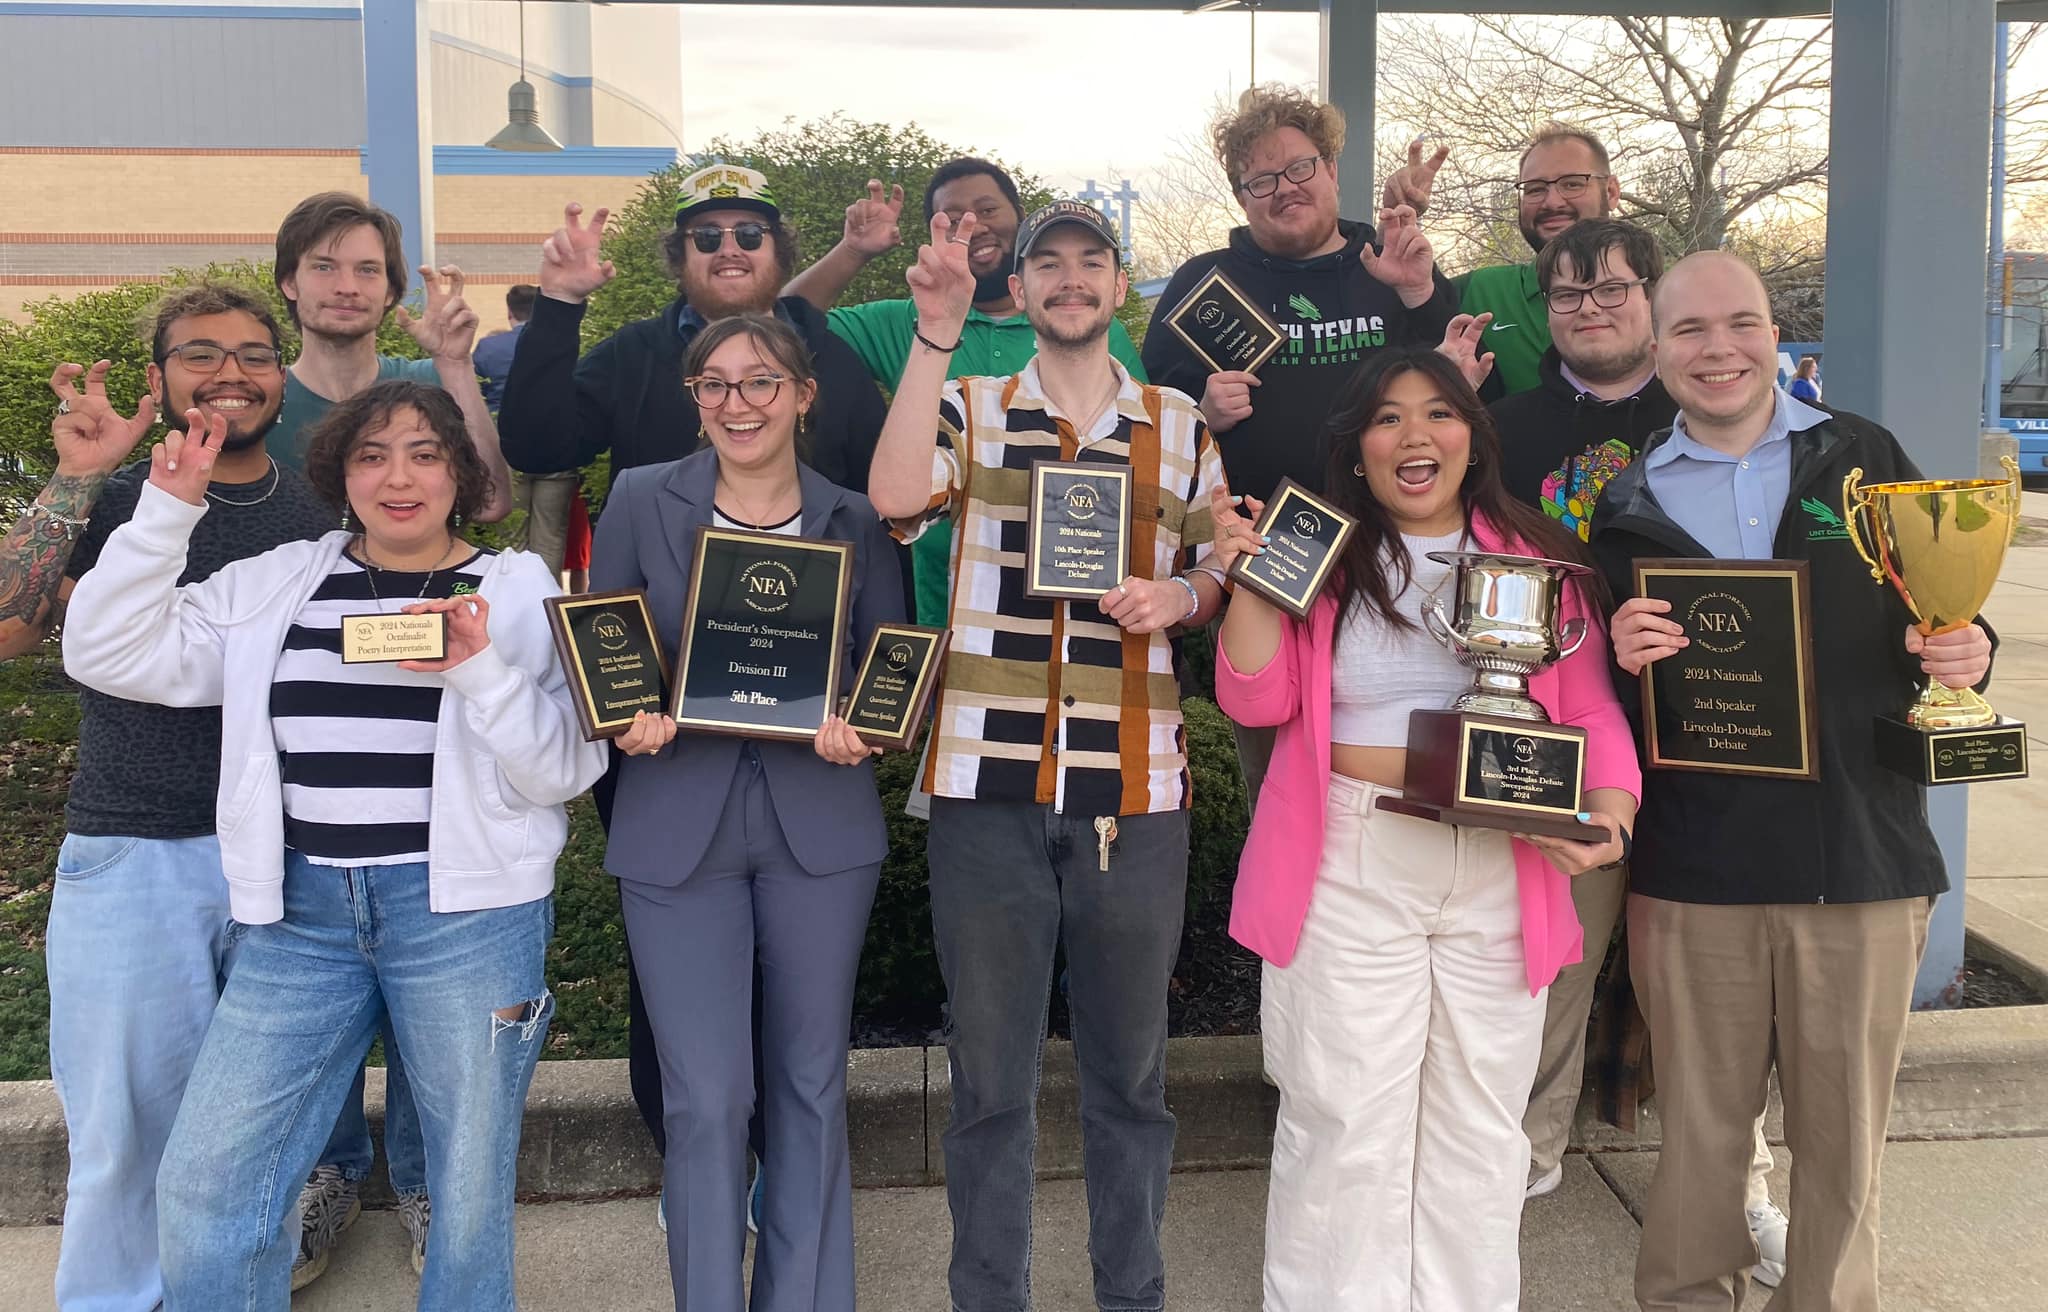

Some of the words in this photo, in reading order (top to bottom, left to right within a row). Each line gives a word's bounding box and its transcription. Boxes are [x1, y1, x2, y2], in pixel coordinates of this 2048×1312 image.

[696, 170, 722, 192] PUPPY
[726, 171, 752, 189] BOWL
[1030, 206, 1056, 231] SAN
[1059, 202, 1103, 226] DIEGO
[1201, 307, 1220, 323] NFA
[1311, 316, 1385, 354] TEXAS
[1070, 495, 1094, 508] NFA
[1296, 516, 1315, 534] NFA
[1075, 528, 1103, 538] Nationals
[1083, 548, 1105, 556] Speaker
[740, 560, 772, 582] NATIONAL
[1055, 560, 1104, 571] Lincoln-Douglas
[1068, 570, 1090, 579] Debate
[749, 576, 787, 596] NFA
[1688, 592, 1718, 620] NATIONAL
[1720, 593, 1752, 622] FORENSIC
[380, 622, 397, 630] 2024
[400, 620, 432, 629] Nationals
[1698, 613, 1742, 632] NFA
[386, 633, 426, 641] Octafinalist
[598, 625, 624, 638] NFA
[707, 620, 758, 633] President's
[761, 625, 818, 640] Sweepstakes
[358, 646, 380, 655] Poetry
[384, 644, 431, 654] Interpretation
[750, 638, 773, 648] 2024
[1696, 639, 1746, 653] ASSOCIATION
[890, 652, 907, 663] NFA
[728, 662, 770, 676] Division
[773, 666, 787, 677] III
[1684, 668, 1710, 681] 2024
[1713, 669, 1763, 683] Nationals
[730, 691, 747, 703] 5th
[751, 692, 778, 706] Place
[1694, 698, 1713, 710] 2nd
[1716, 698, 1756, 713] Speaker
[1683, 721, 1772, 737] Lincoln-Douglas
[1517, 744, 1532, 755] NFA
[1709, 738, 1748, 750] Debate
[1507, 765, 1519, 773] 3rd
[1521, 766, 1539, 775] Place
[1481, 770, 1538, 783] Lincoln-Douglas
[1539, 778, 1564, 786] Debate
[1500, 782, 1543, 792] Sweepstakes
